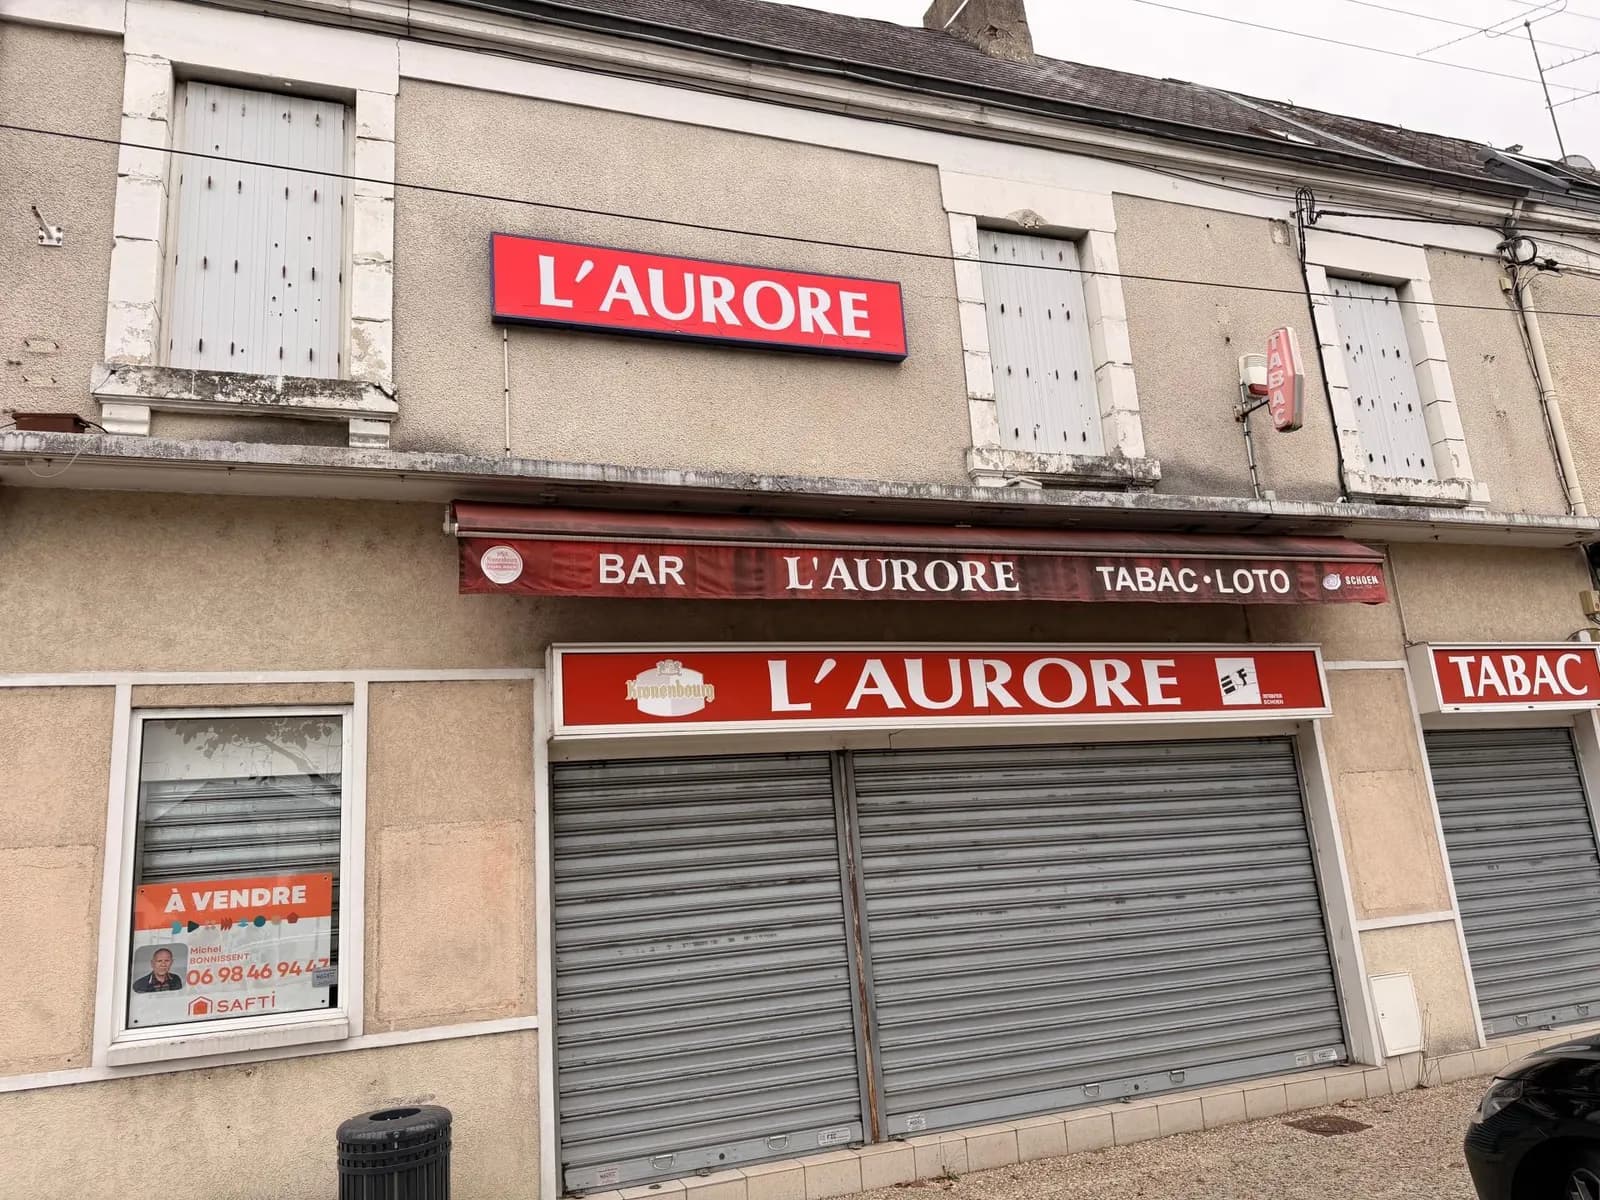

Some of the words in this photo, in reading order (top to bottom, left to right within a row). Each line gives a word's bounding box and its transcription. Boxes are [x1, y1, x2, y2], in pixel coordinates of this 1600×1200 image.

[537, 254, 871, 339] L'AURORE
[1268, 333, 1285, 427] TABAC
[599, 553, 686, 586] BAR
[783, 555, 1021, 593] L'AURORE
[1344, 575, 1379, 585] SCHOEN
[625, 679, 715, 703] Kronenbourg
[767, 657, 1182, 712] L'AURORE
[1448, 653, 1588, 698] TABAC
[164, 888, 186, 913] À
[192, 884, 307, 911] VENDRE
[189, 952, 250, 965] BONNISSENT
[190, 945, 222, 955] Michel
[186, 968, 213, 986] 06
[218, 965, 244, 982] 98
[247, 962, 273, 980] 46
[277, 959, 302, 977] 94
